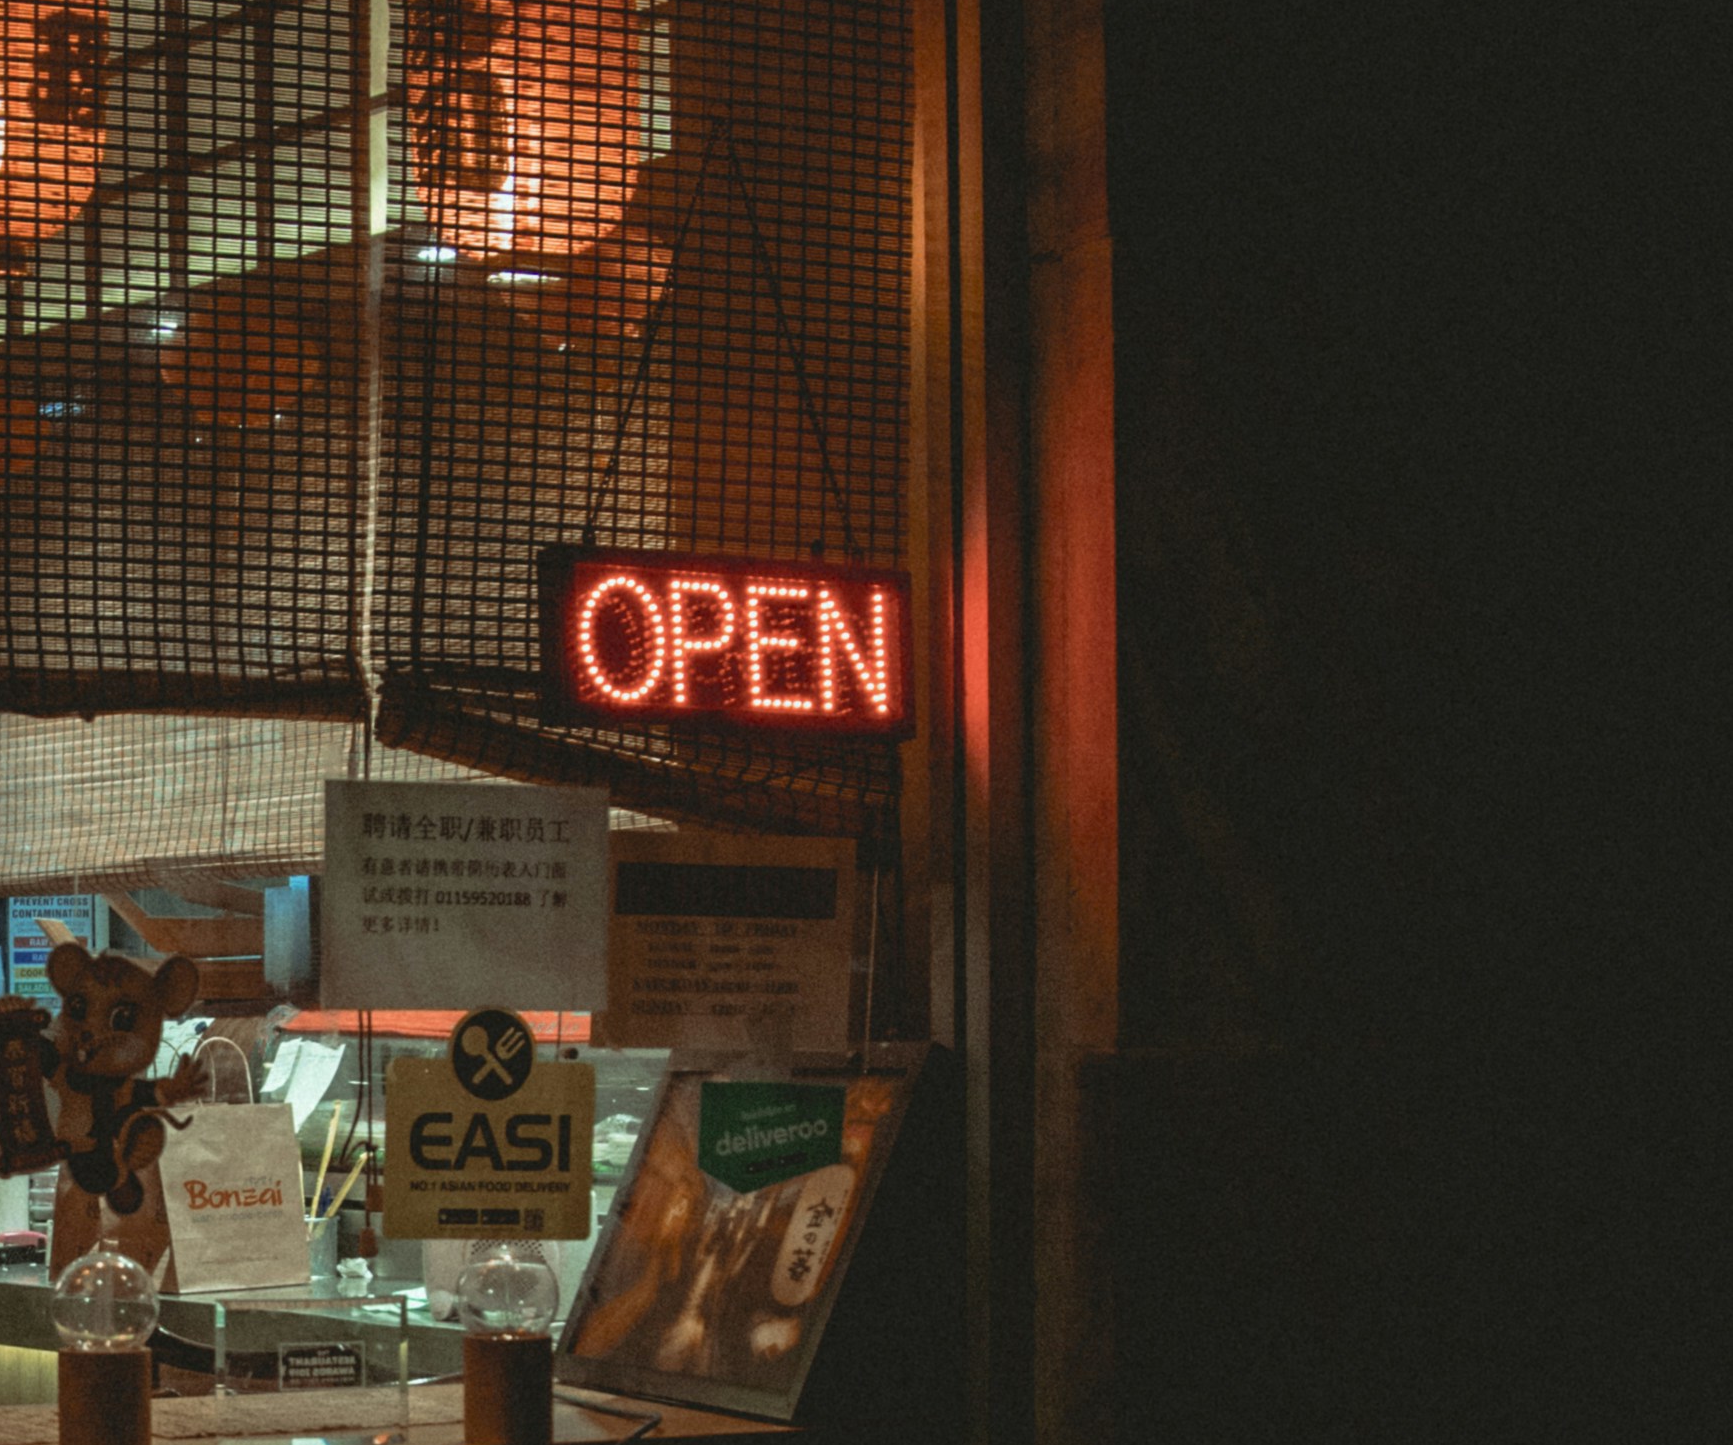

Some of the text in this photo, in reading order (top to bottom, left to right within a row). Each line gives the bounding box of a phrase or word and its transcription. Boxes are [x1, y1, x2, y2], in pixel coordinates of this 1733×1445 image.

[577, 573, 890, 715] OPEN
[12, 909, 89, 919] CONTAMINATION
[13, 897, 89, 906] PREVENT CROSS
[409, 1111, 572, 1173] EASI
[715, 1118, 828, 1157] deliveroo
[183, 1179, 283, 1211] Bonzai
[410, 1180, 571, 1194] NO.1 ASIAN FOOD DELIVERY
